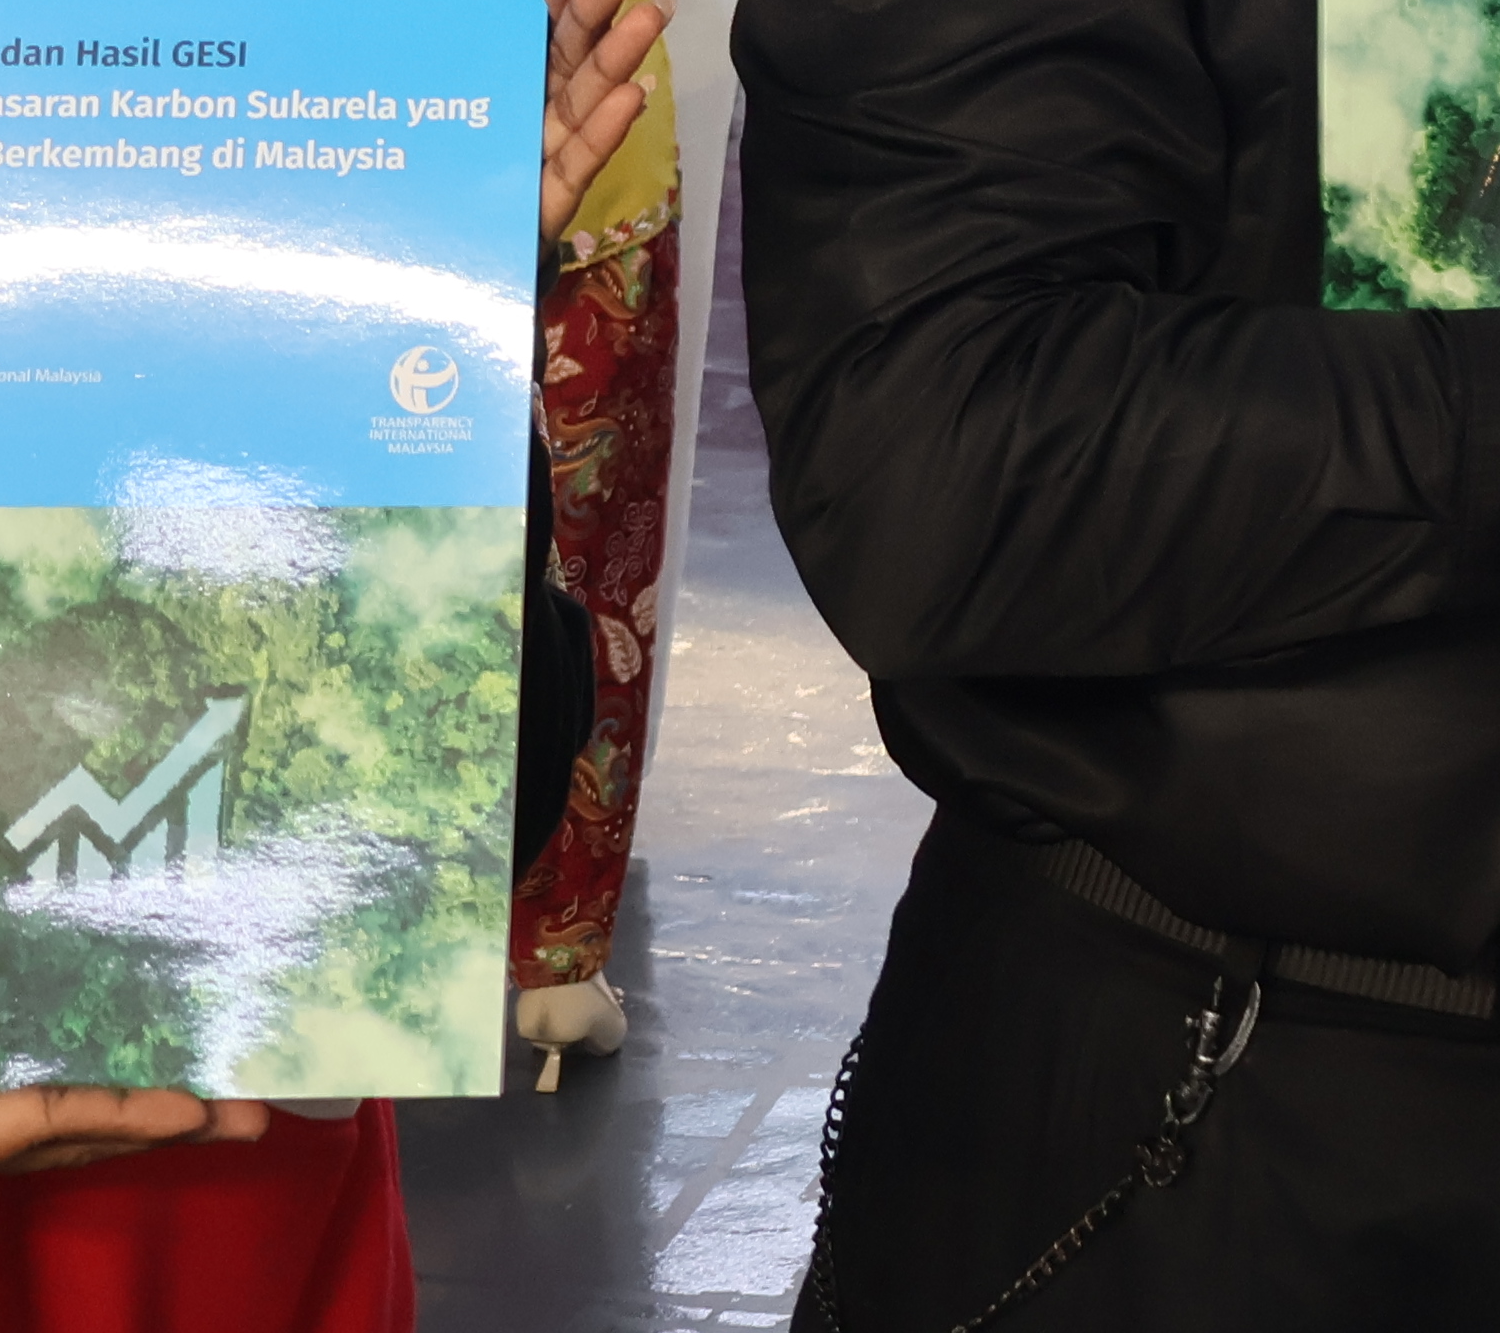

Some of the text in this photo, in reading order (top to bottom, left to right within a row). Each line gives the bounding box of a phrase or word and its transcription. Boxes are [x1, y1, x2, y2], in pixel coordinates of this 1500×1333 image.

[1, 38, 63, 66] dan
[77, 37, 160, 66] Hasil
[173, 41, 246, 67] GESI
[111, 89, 237, 118] Karbon
[247, 89, 398, 120] Sukarela
[407, 97, 490, 128] yang
[212, 137, 245, 169] di
[255, 139, 406, 176] Malaysia
[36, 368, 101, 384] Malaysia
[370, 416, 474, 429] TRANSPARENCY
[368, 428, 473, 441] INTERNATIONAL
[387, 442, 454, 454] MALAYSIA
